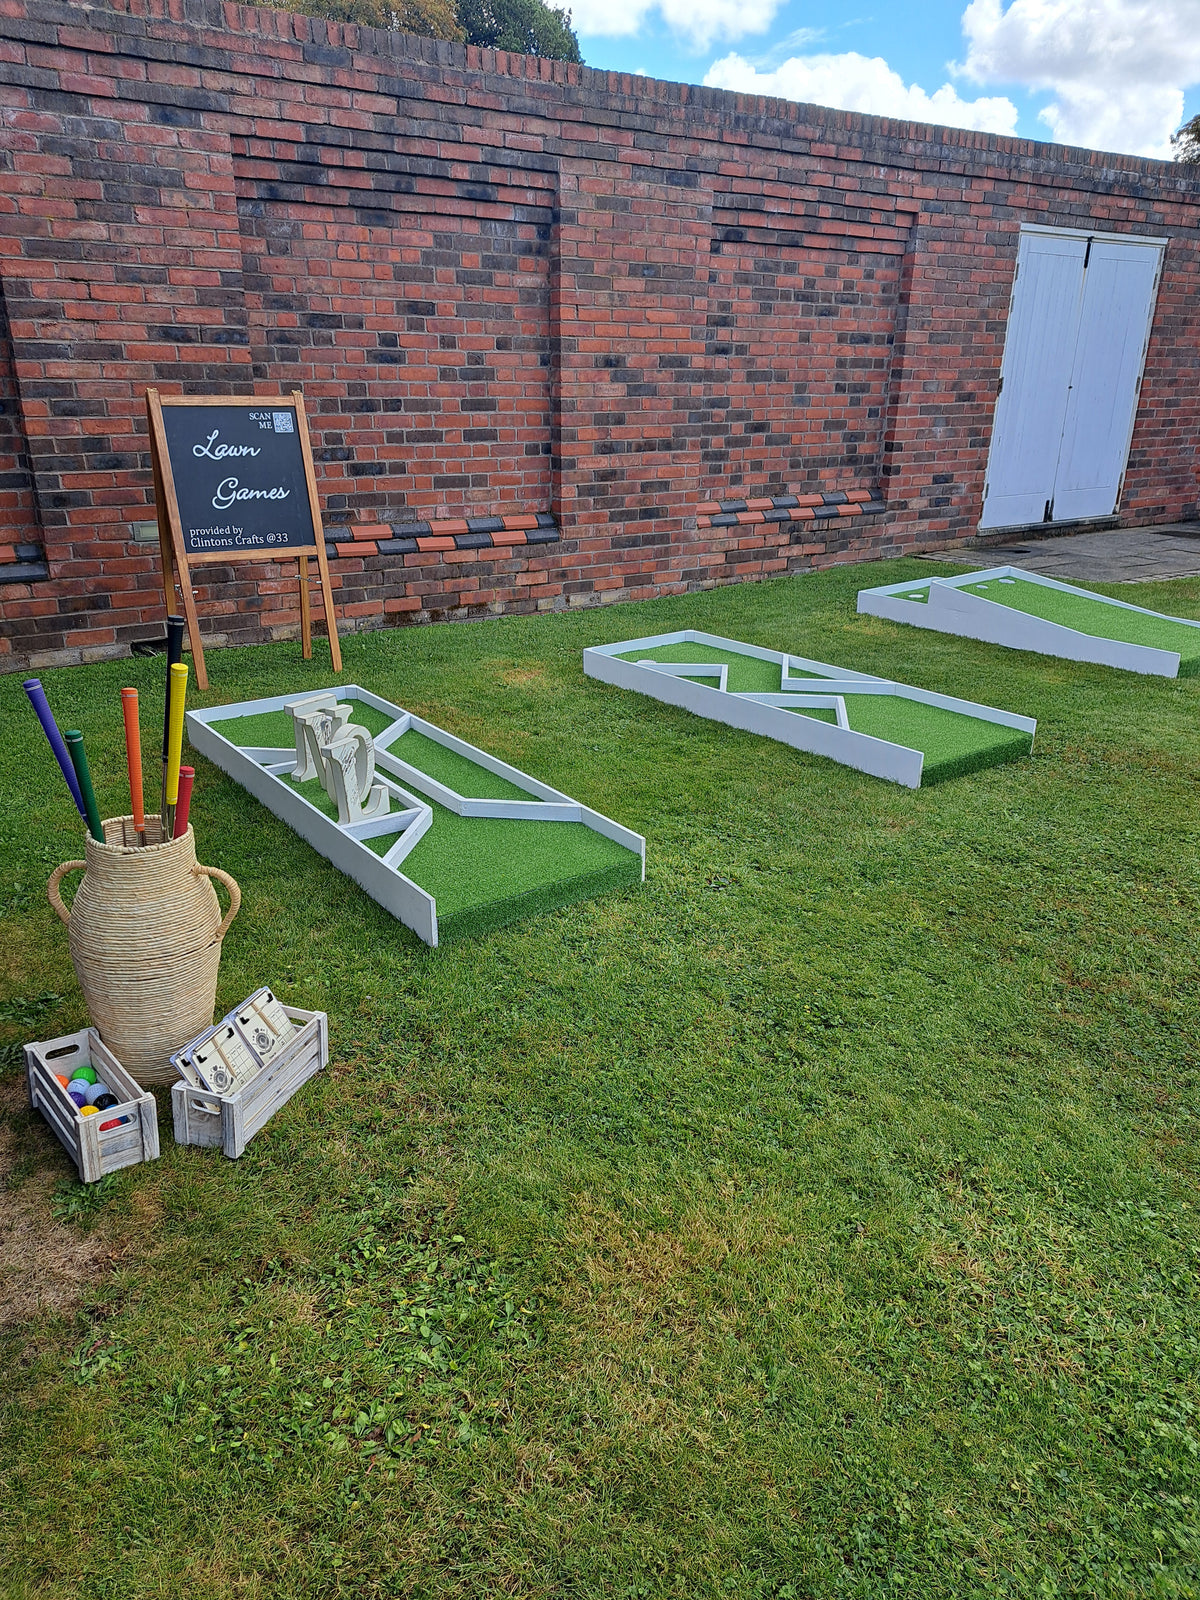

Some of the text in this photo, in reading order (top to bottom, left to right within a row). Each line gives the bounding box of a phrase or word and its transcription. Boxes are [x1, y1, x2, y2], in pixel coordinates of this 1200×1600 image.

[249, 412, 271, 420] SCAN
[259, 421, 272, 429] ME
[193, 430, 261, 460] Lawn
[212, 477, 290, 509] Games
[189, 525, 243, 537] provided by
[190, 532, 289, 547] Clintons Crafts @33
